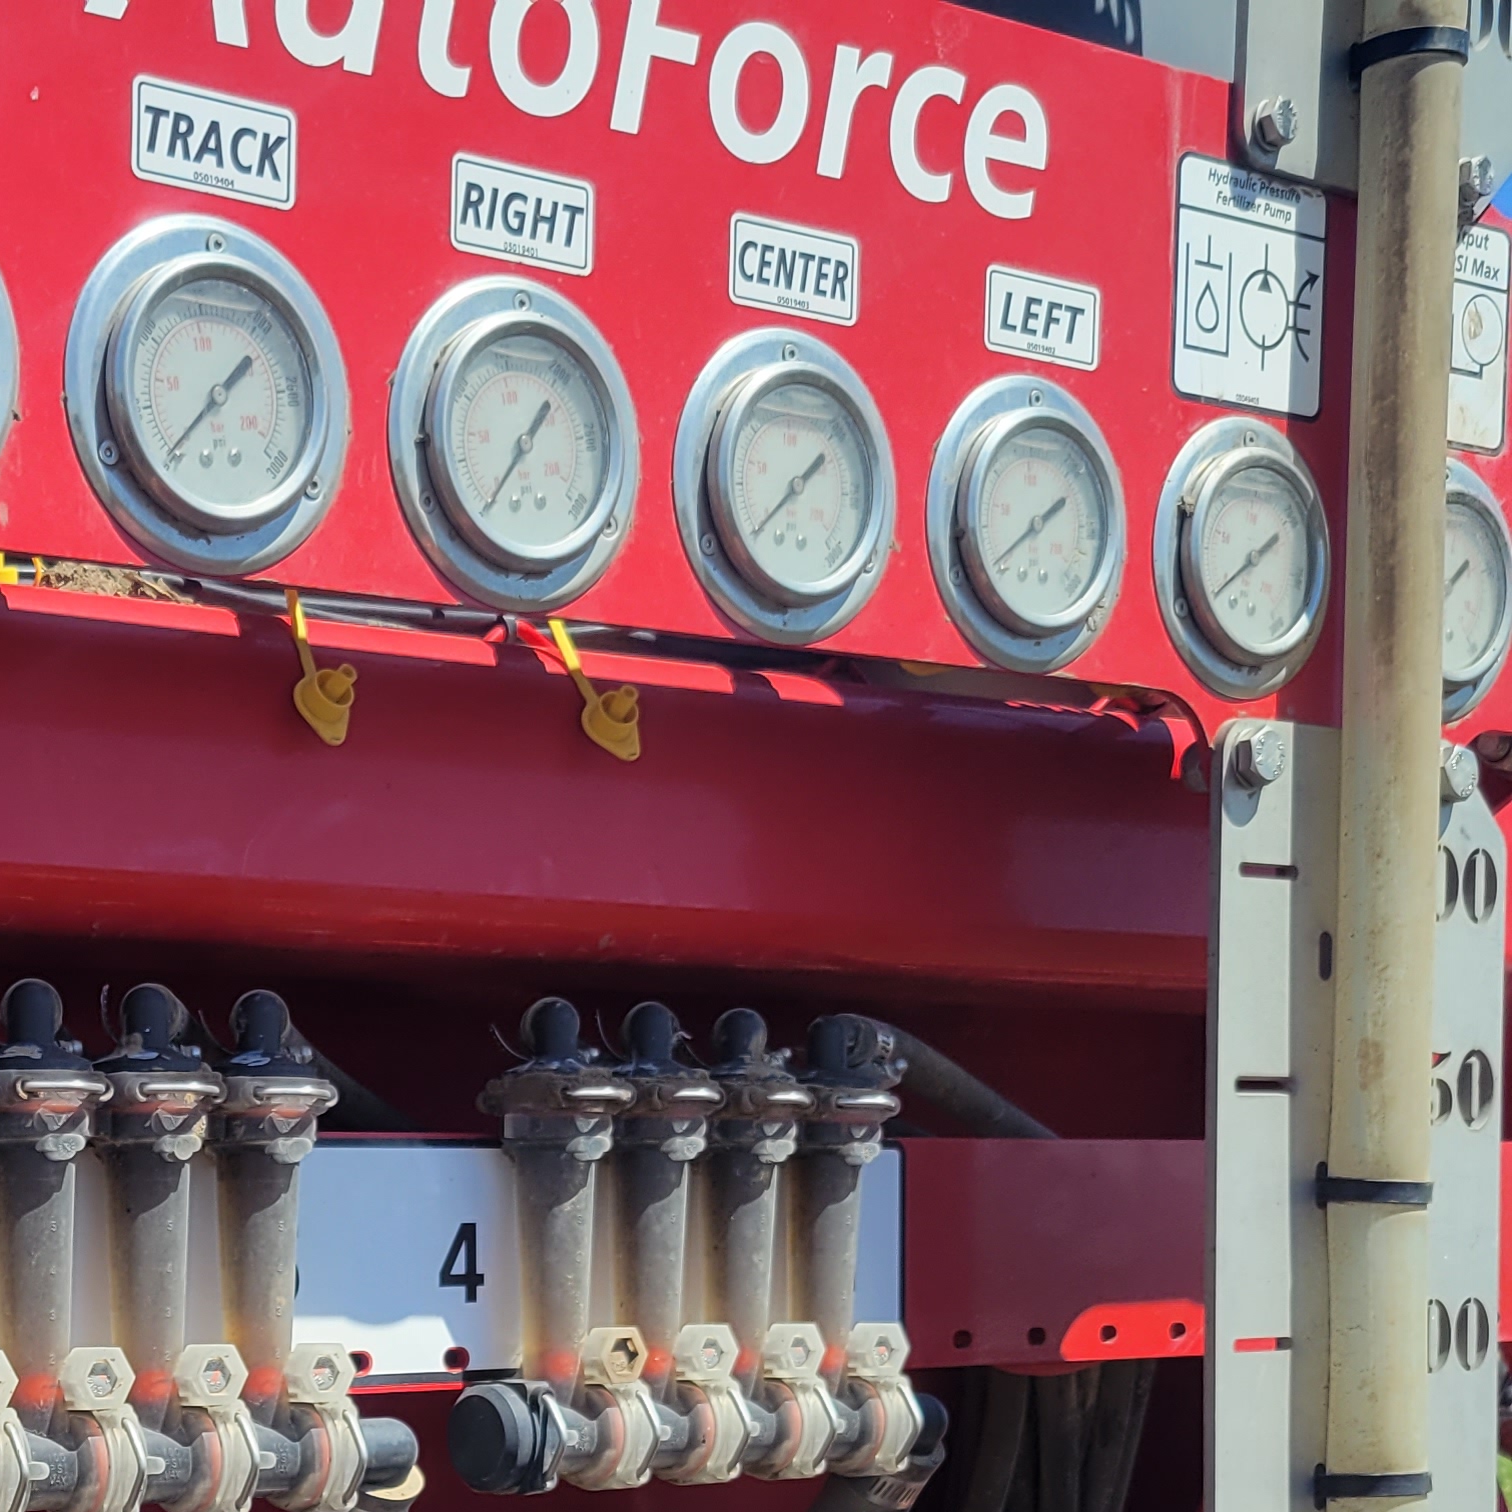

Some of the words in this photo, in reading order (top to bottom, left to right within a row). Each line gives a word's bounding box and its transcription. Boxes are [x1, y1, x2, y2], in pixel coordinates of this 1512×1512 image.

[84, 0, 1050, 220] utoForce
[144, 104, 288, 182] TRACK
[1208, 167, 1258, 193] Hydraulic
[1258, 180, 1302, 204] Pressure
[1216, 190, 1263, 214] Fertilizer
[1263, 202, 1292, 224] Pump
[459, 181, 585, 248] RIGHT
[738, 240, 849, 302] CENTER
[1471, 257, 1500, 282] Max
[999, 291, 1086, 345] LEFT
[193, 337, 212, 352] 100
[166, 376, 179, 391] 50
[240, 416, 258, 431] 200
[438, 1222, 485, 1304] 4
